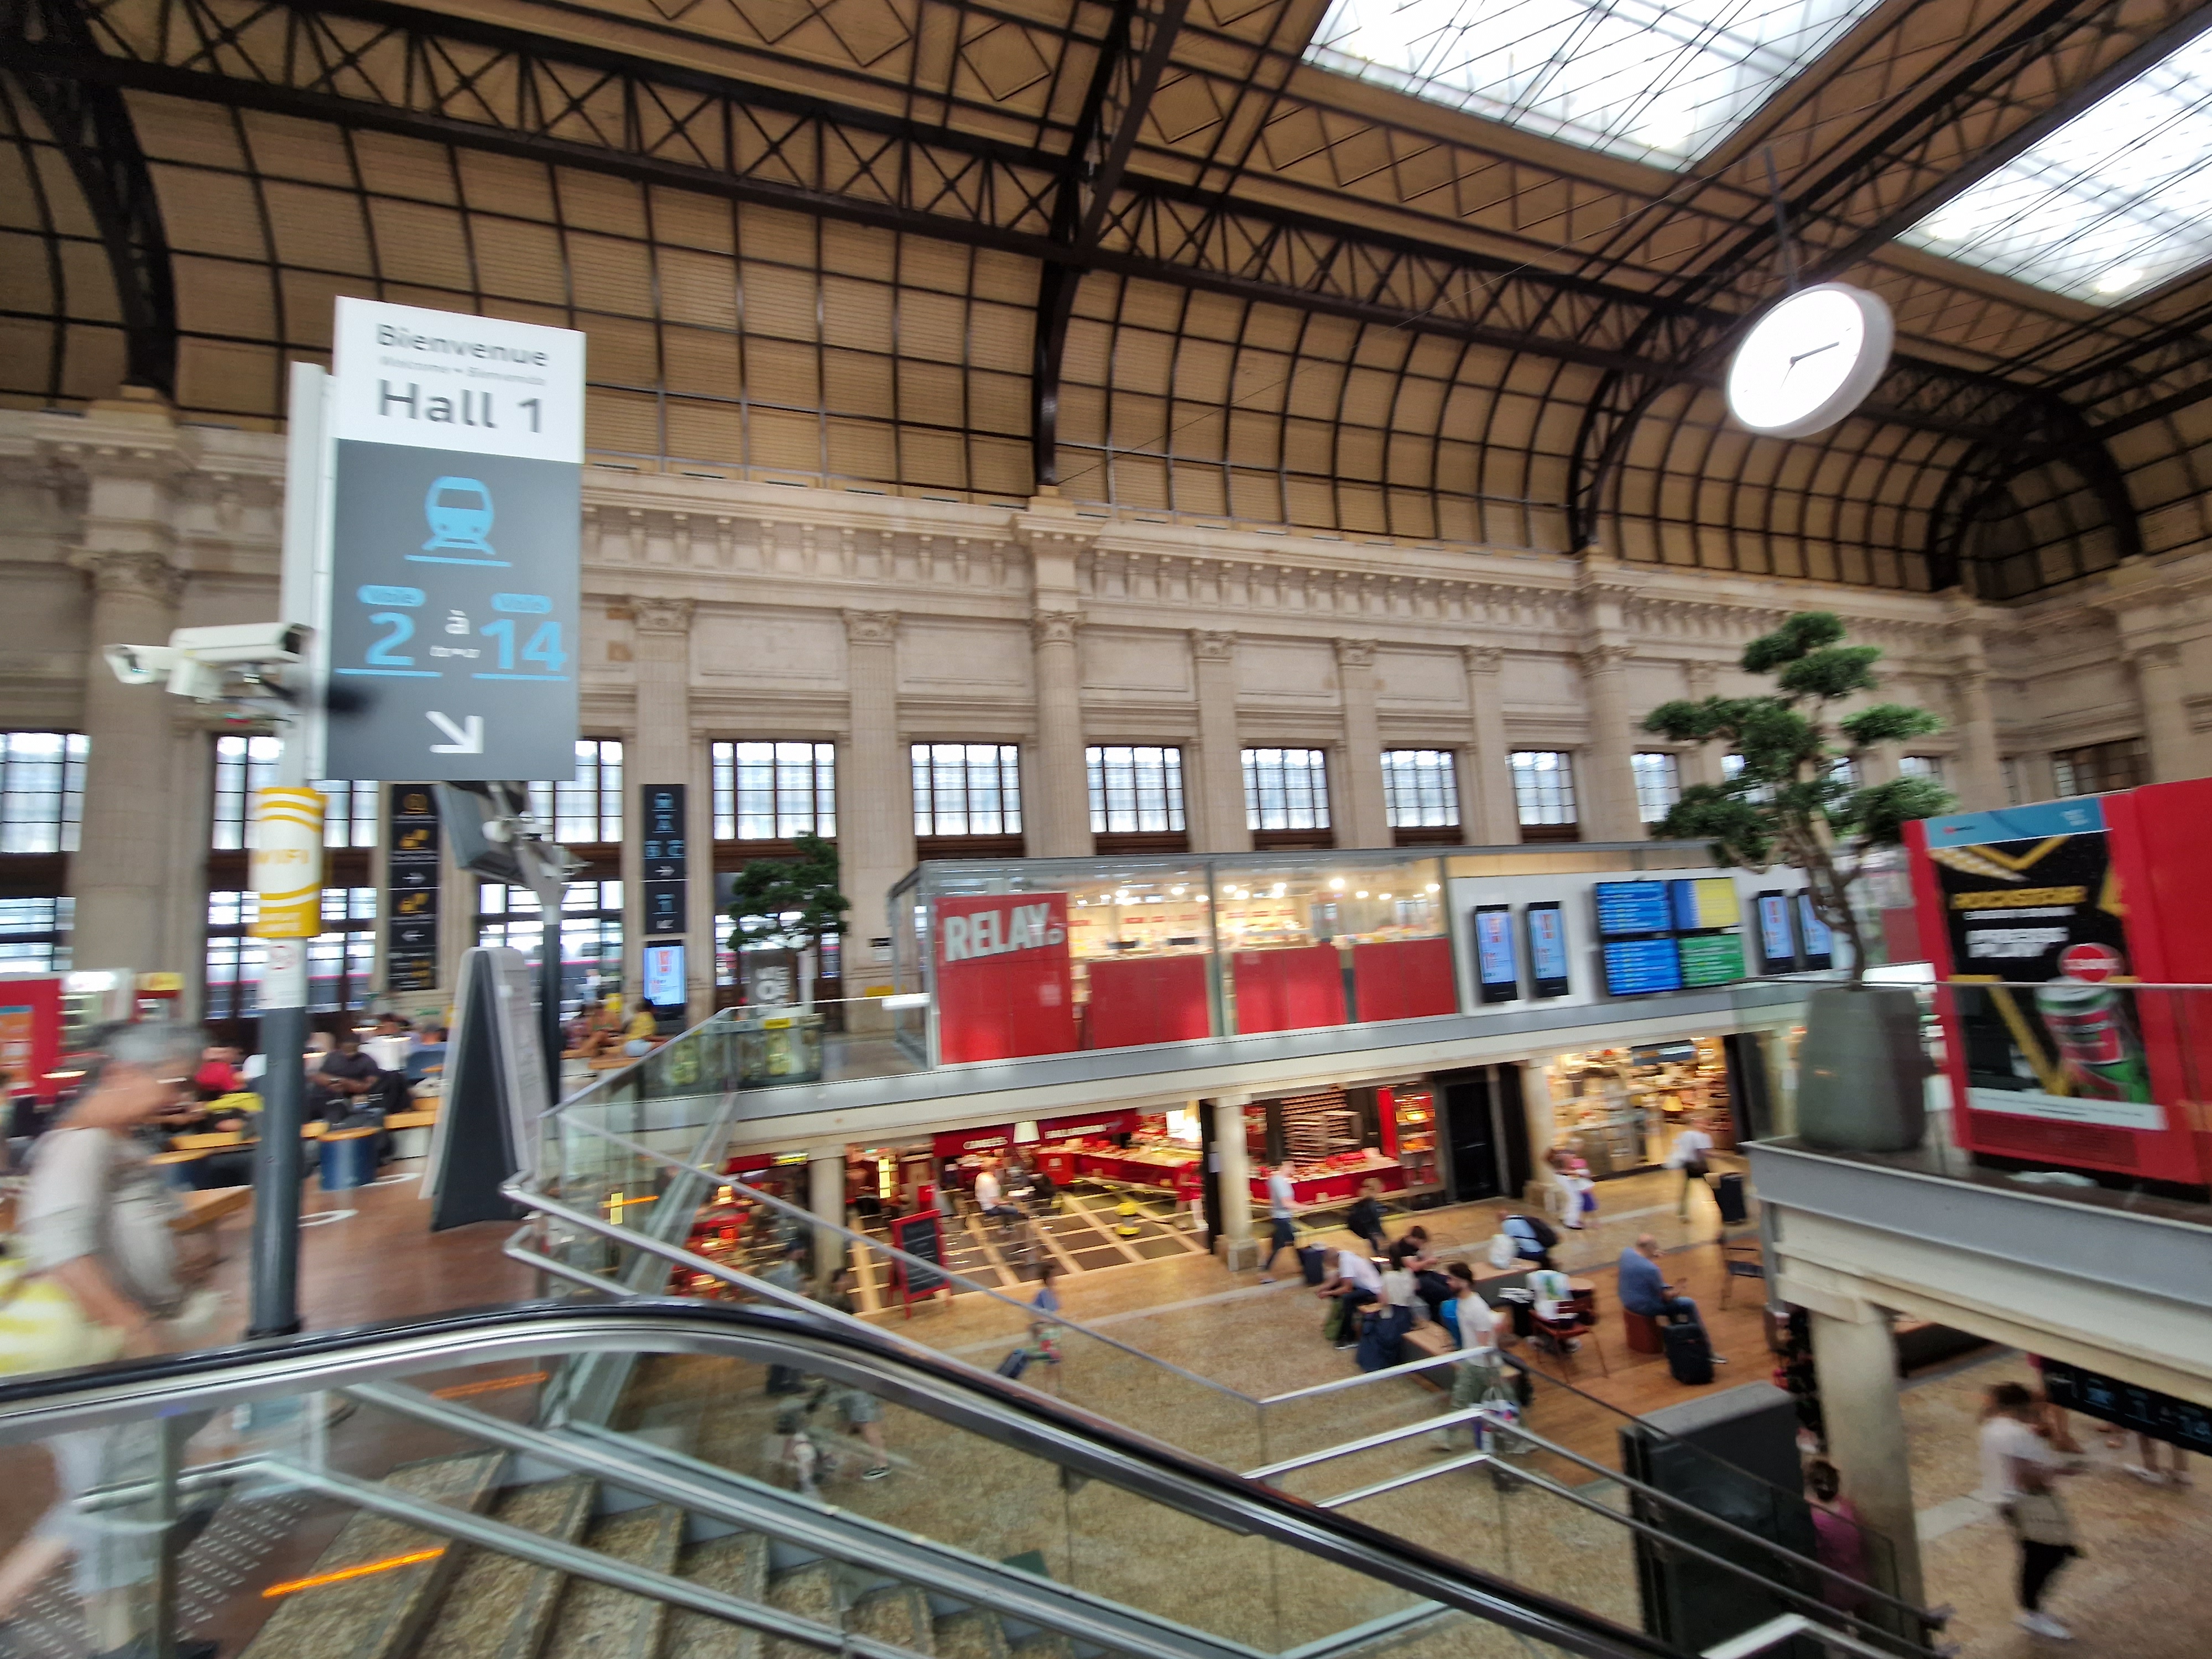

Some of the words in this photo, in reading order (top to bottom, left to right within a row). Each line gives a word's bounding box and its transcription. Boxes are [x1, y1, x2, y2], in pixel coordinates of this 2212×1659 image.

[377, 323, 547, 367] Bienvenue
[377, 378, 499, 429] Hall
[518, 398, 544, 433] 1
[365, 612, 415, 666] 2
[445, 609, 470, 635] à
[479, 618, 569, 671] 14
[943, 902, 1051, 962] RELAY
